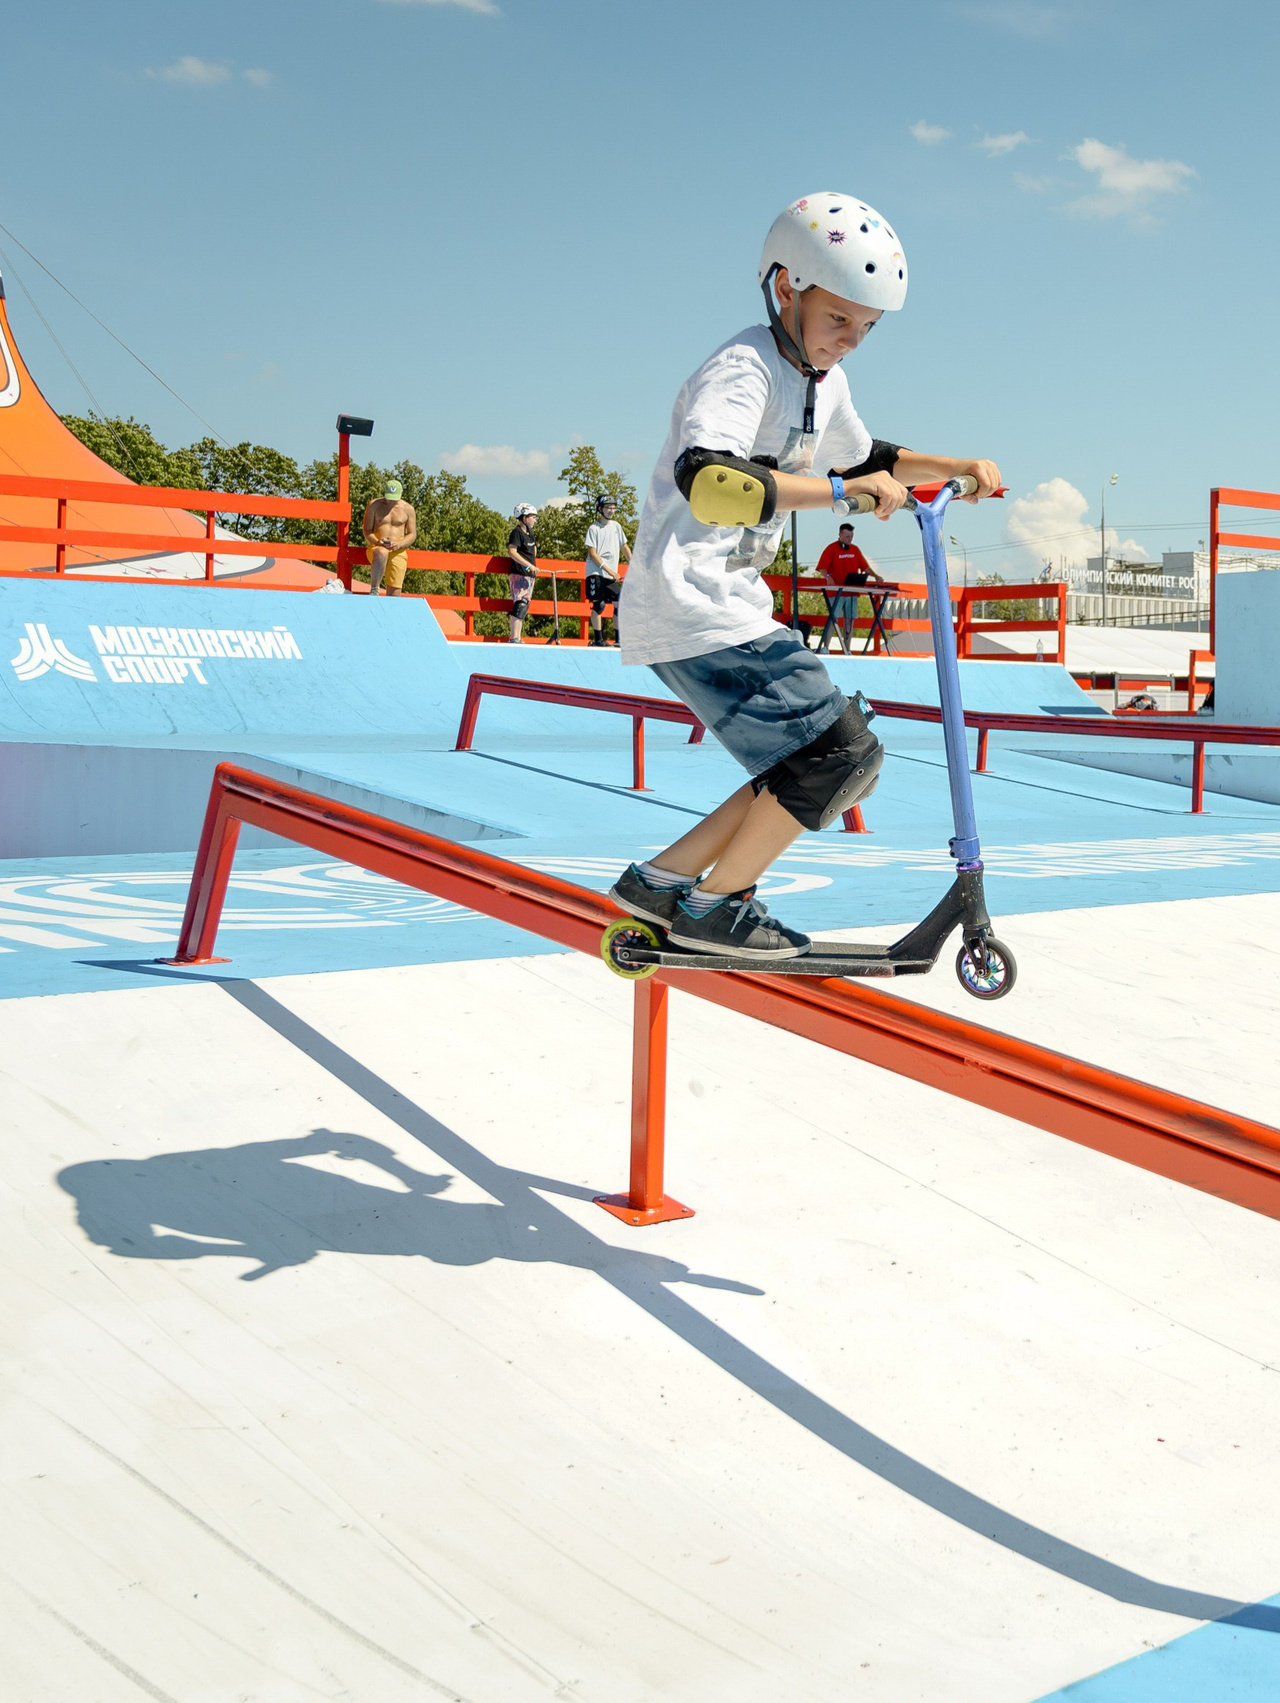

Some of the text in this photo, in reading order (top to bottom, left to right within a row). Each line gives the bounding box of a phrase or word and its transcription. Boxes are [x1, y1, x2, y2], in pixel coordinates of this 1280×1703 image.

[1136, 573, 1176, 588] КОМИТЕТ
[88, 624, 304, 660] МОСКОВСКИЙ
[100, 655, 209, 685] СПОРТ
